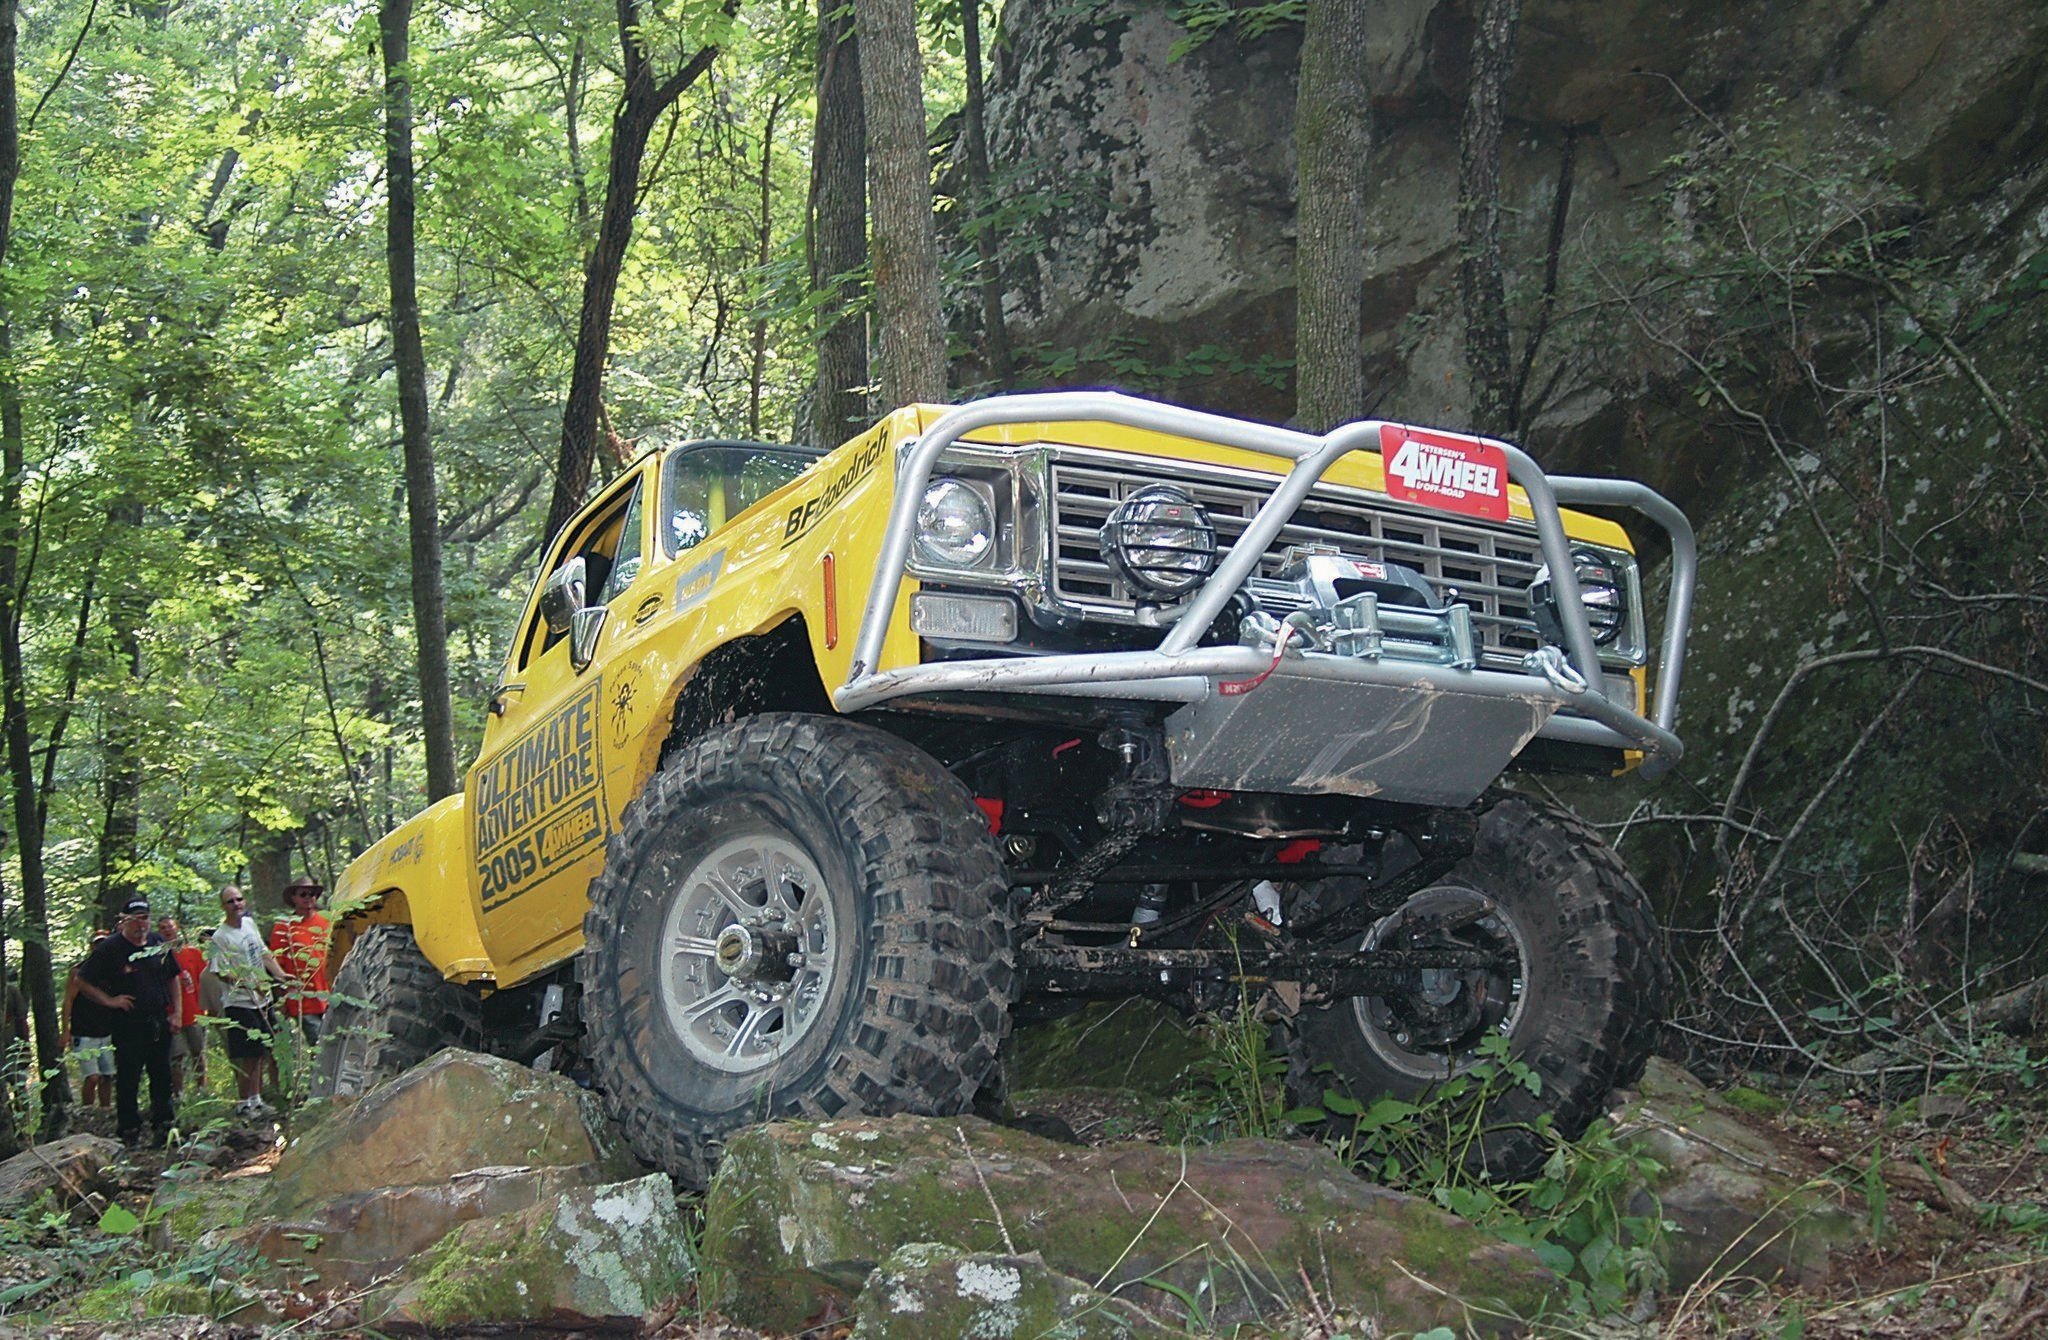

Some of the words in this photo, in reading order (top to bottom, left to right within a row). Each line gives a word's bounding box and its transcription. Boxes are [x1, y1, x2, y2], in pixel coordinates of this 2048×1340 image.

[784, 426, 888, 540] BFGoodrich
[1419, 444, 1466, 460] PETERSEN'S
[477, 693, 594, 816] ULTIMATE
[477, 744, 594, 856] ADVENTURE
[478, 835, 537, 901] 2005
